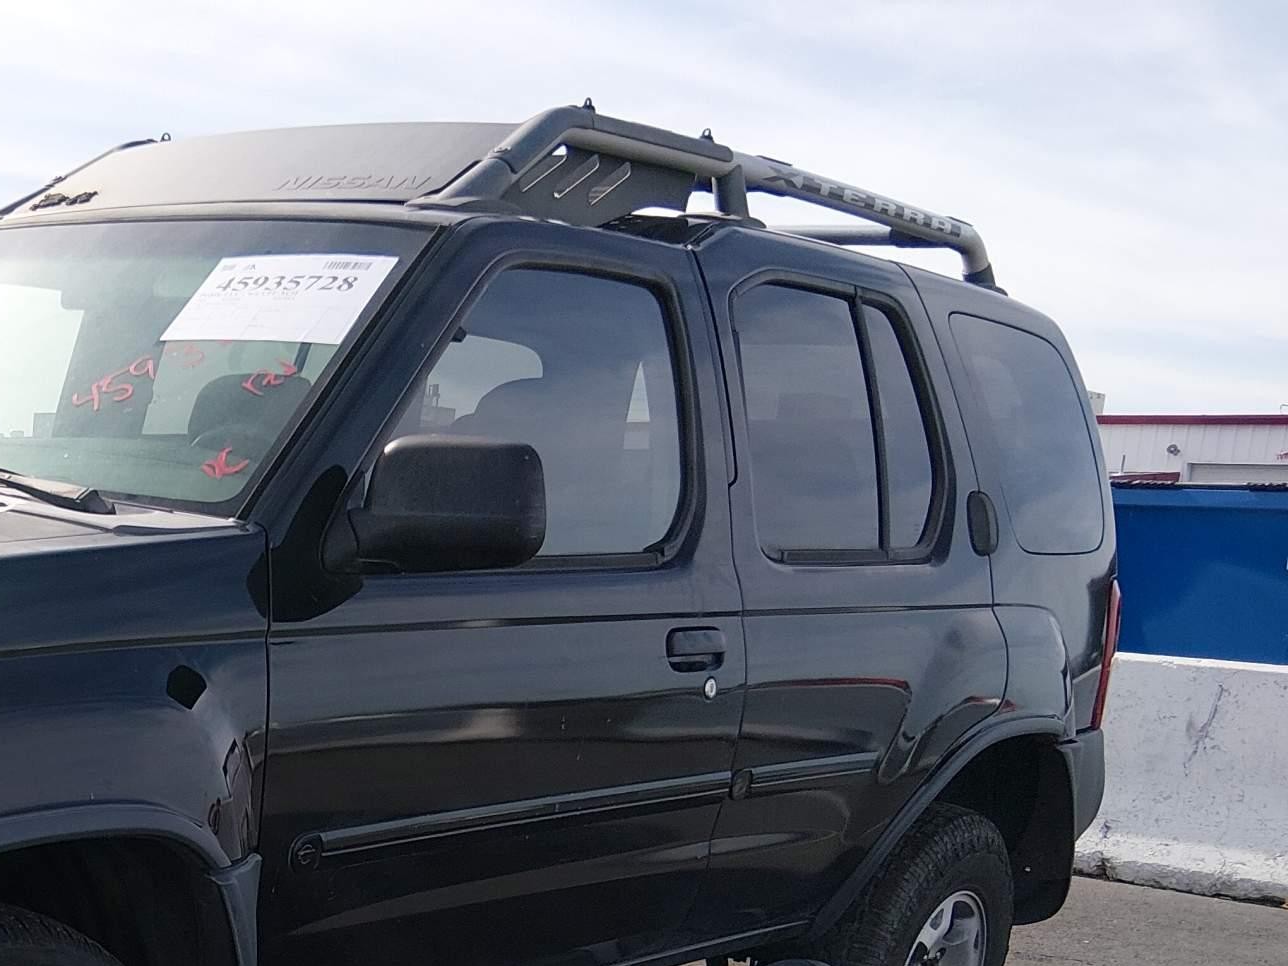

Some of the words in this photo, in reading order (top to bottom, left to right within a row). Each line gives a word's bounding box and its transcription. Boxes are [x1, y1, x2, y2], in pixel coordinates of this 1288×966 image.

[273, 175, 433, 191] NISSAN
[761, 165, 955, 236] XTERRA
[216, 275, 359, 292] 45935728
